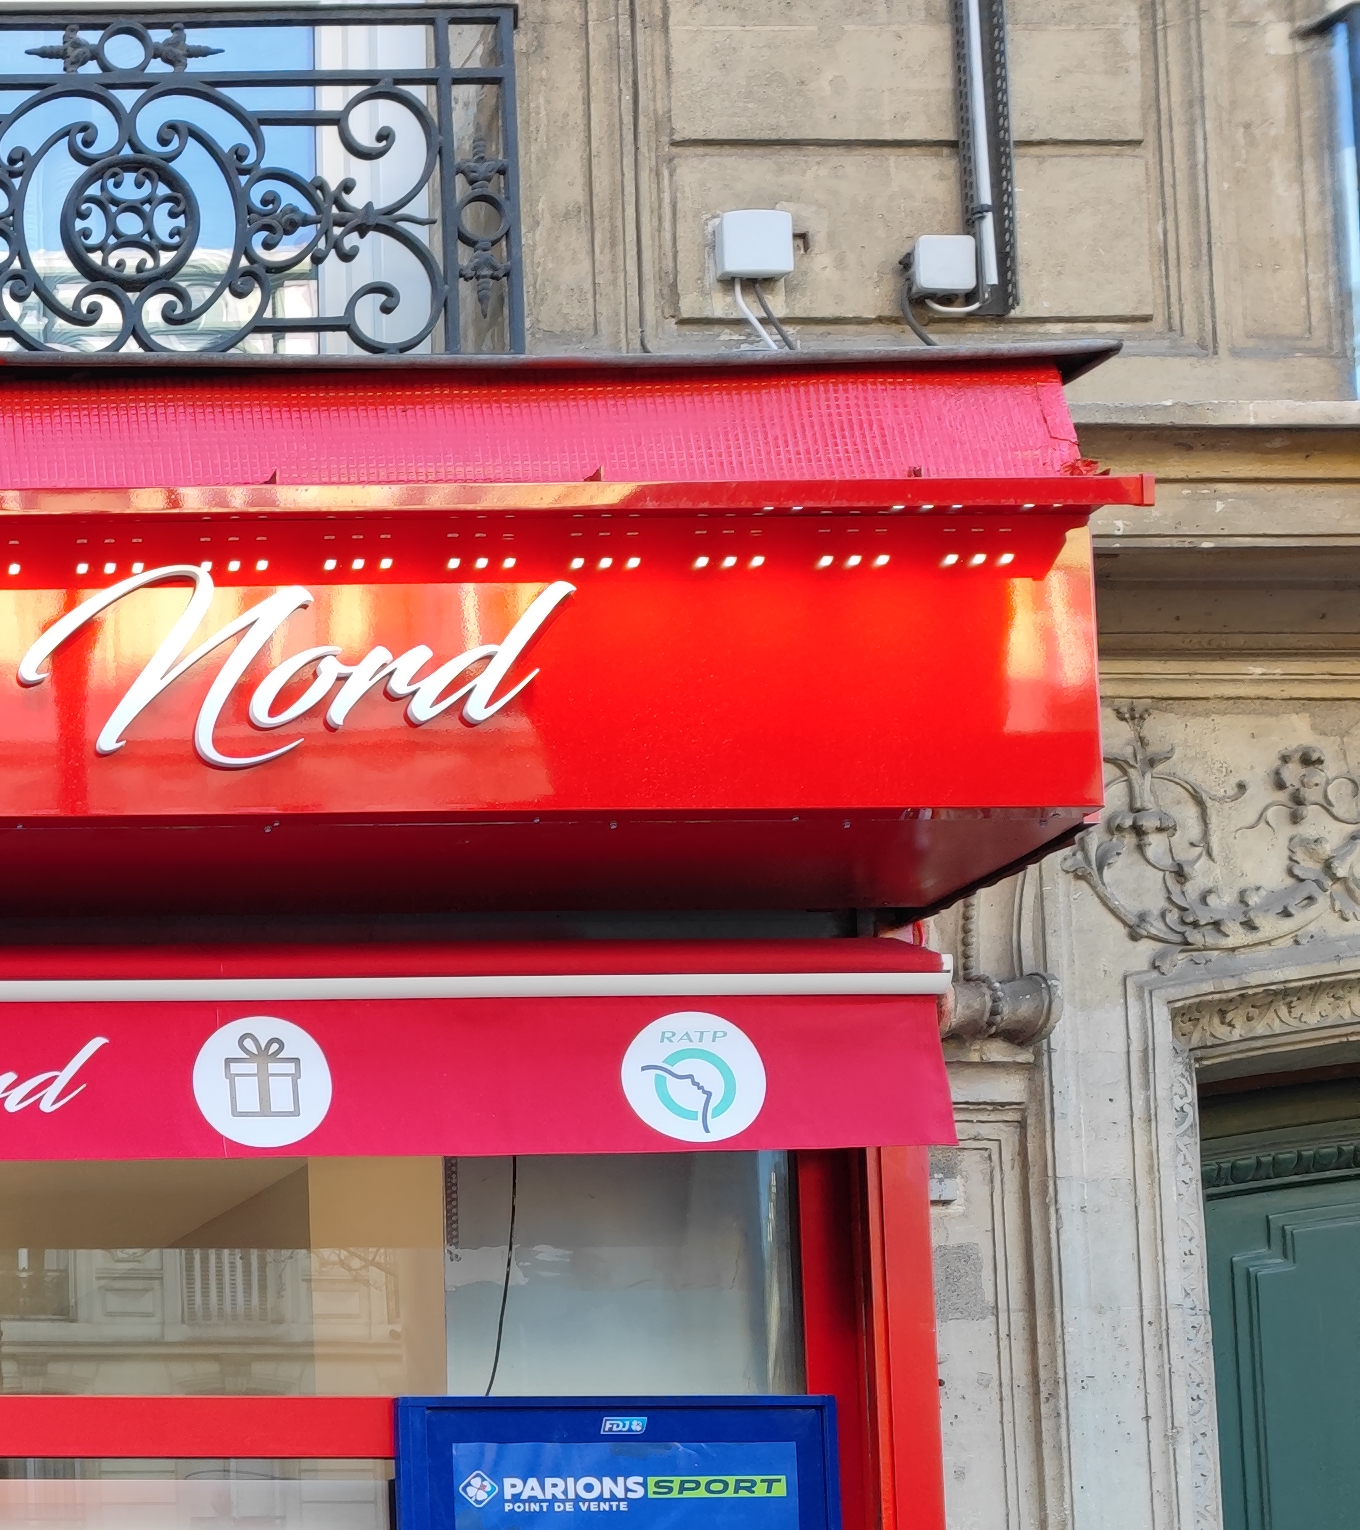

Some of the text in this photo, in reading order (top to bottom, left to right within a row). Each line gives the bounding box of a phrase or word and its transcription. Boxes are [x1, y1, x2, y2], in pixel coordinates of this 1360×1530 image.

[17, 565, 578, 771] Nord
[659, 1030, 728, 1044] RATP
[604, 1420, 630, 1431] FDJ
[502, 1476, 783, 1500] PARIONS SPORT
[504, 1500, 629, 1512] POINT DE VENTE
